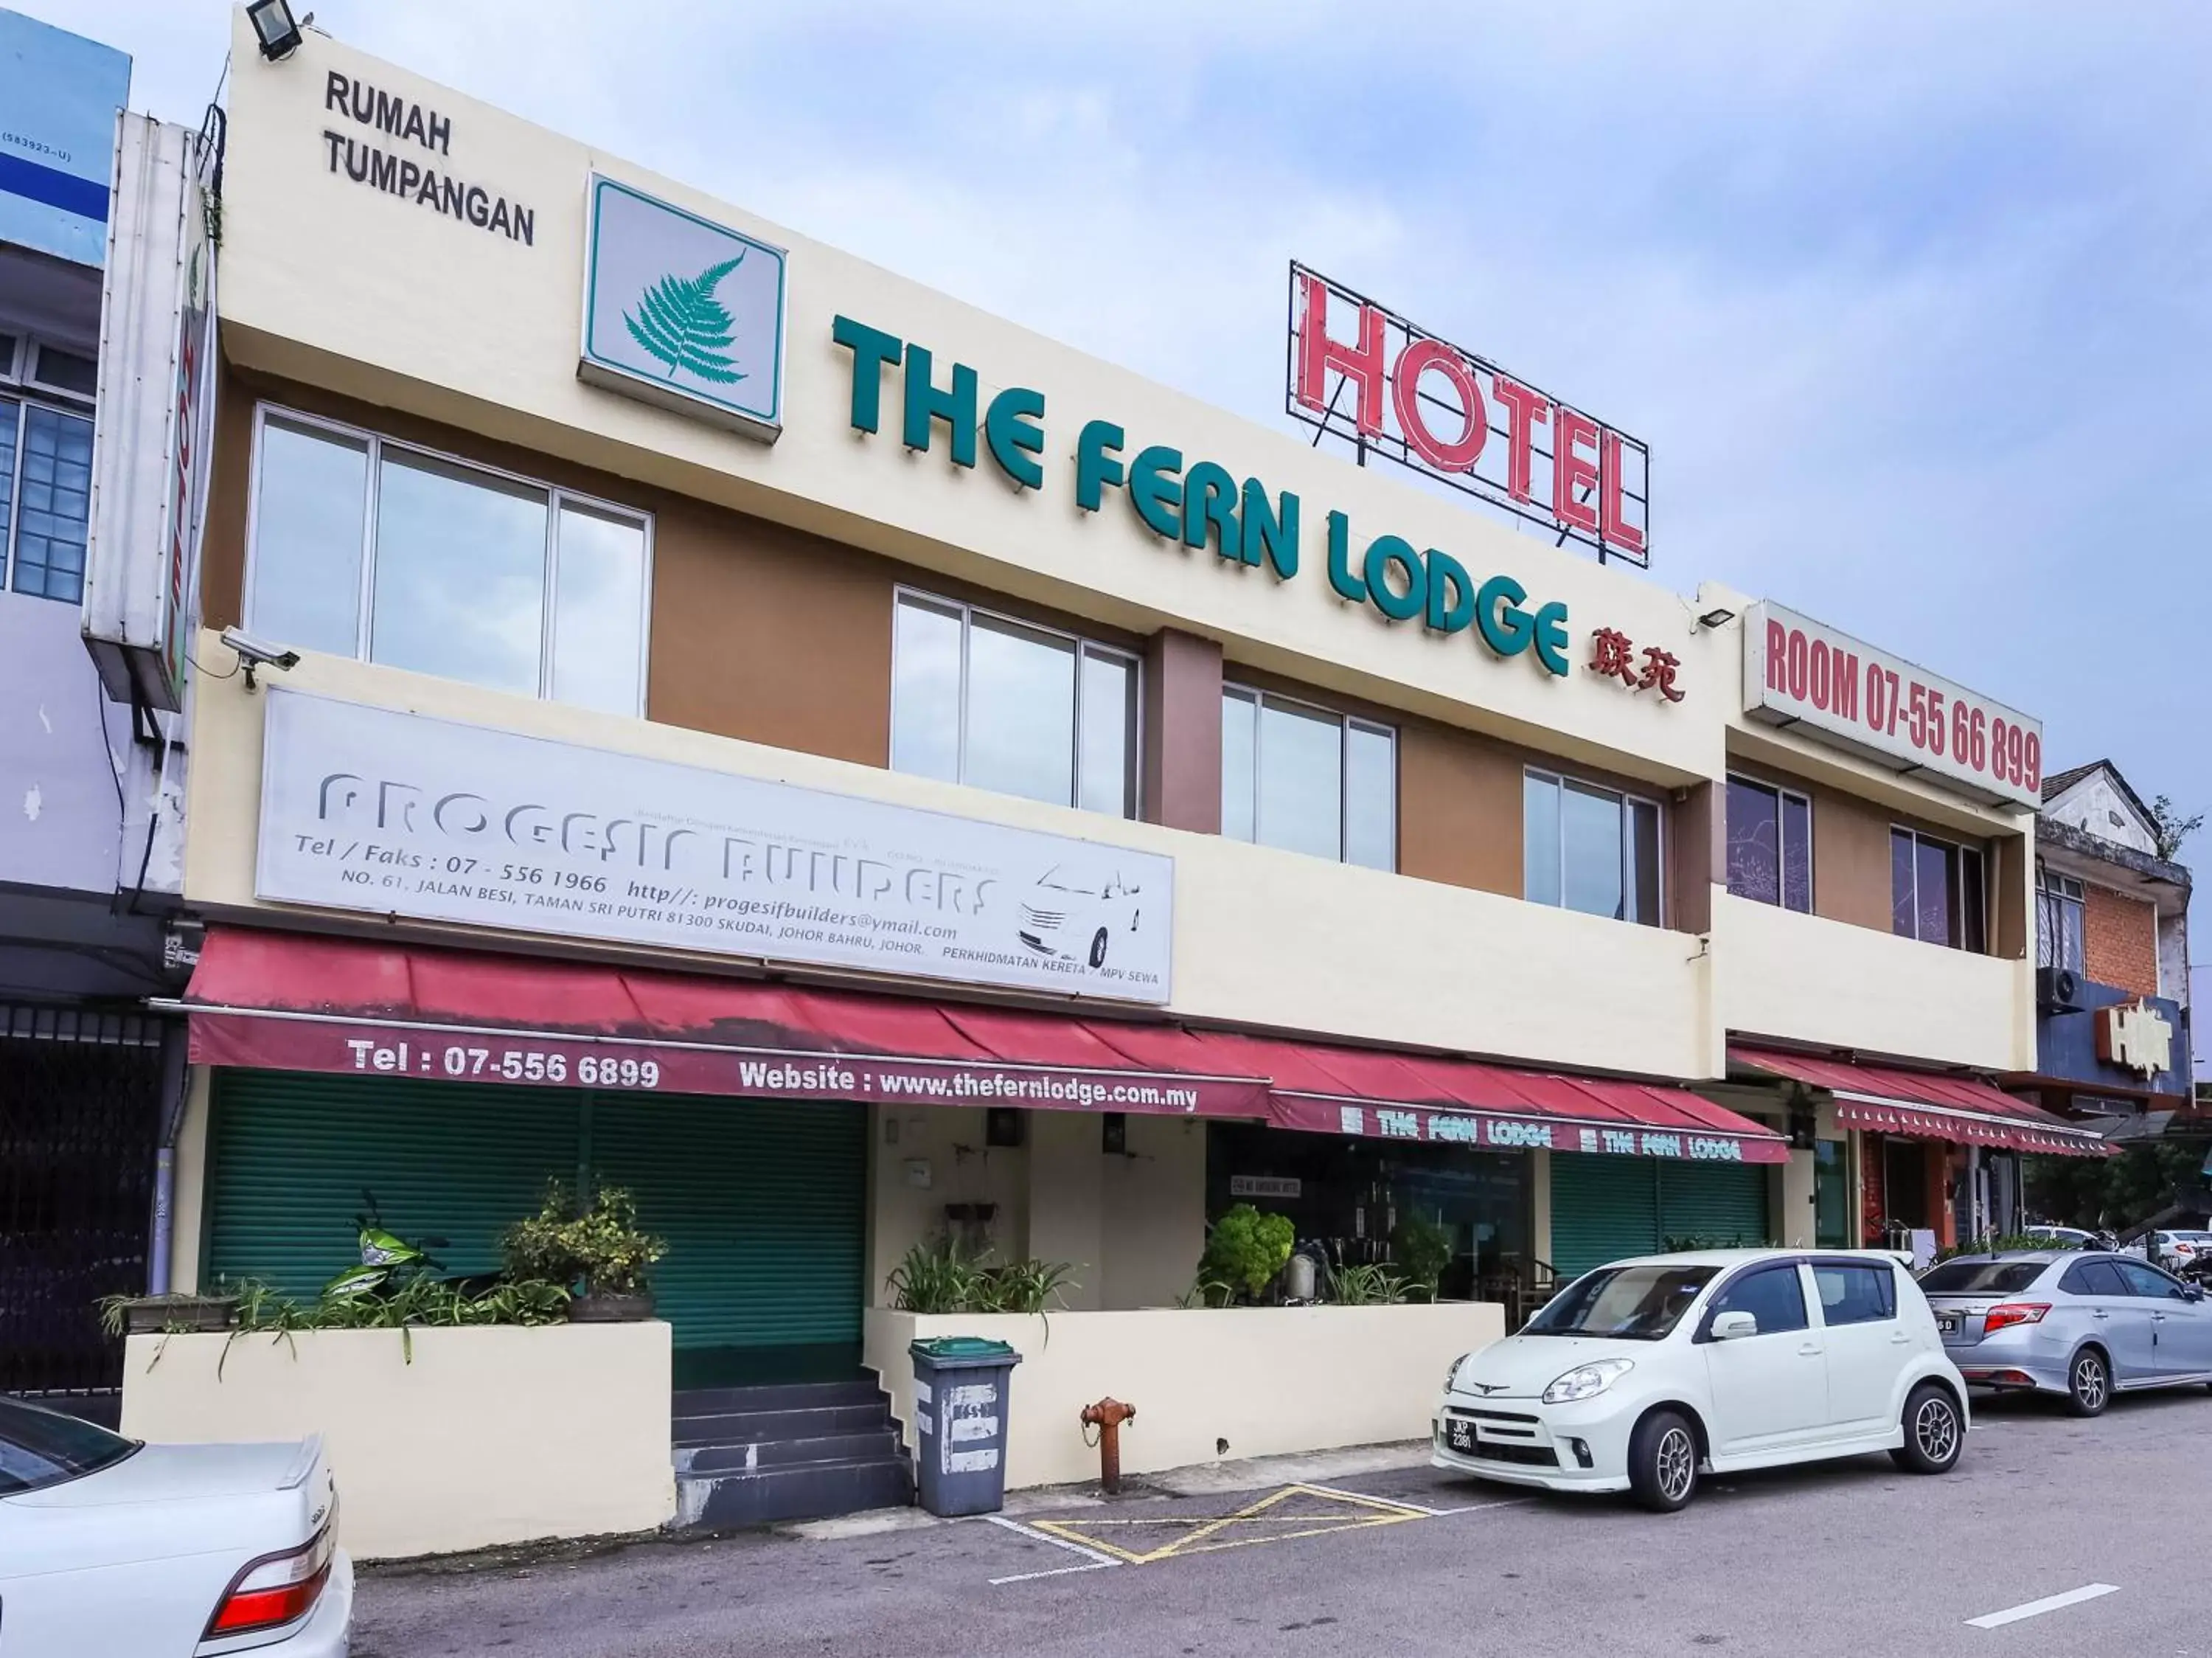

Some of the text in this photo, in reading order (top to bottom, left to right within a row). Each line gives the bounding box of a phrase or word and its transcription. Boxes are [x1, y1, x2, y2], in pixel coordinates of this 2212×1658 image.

[325, 70, 451, 156] RUMAH
[323, 131, 535, 247] TUMPANGAN
[1298, 272, 1647, 555] HOTEL
[832, 314, 1569, 677] THE FERN LODGE
[1767, 618, 2040, 792] ROOM 07-55 66 899
[295, 835, 335, 856] Tel
[365, 844, 422, 868] Faks
[446, 856, 477, 875] 07
[500, 864, 543, 884] 556
[553, 870, 608, 892] 1966
[704, 894, 957, 940] progesifbuilders@ymail.com
[341, 869, 375, 886] NO.
[416, 879, 473, 898] JALAN
[477, 887, 517, 906] BESI,
[525, 892, 584, 911] TAMAN
[588, 901, 613, 916] SRI
[617, 907, 662, 922] PUTRI
[666, 914, 713, 928] 81300
[718, 918, 773, 937] SKUDAI,
[777, 926, 824, 943] JOHOR
[828, 933, 875, 951] BAHRU,
[942, 946, 1037, 968] PERKHIDMATAN
[1042, 960, 1086, 976] KERETA
[1100, 967, 1125, 980] MPV
[1128, 971, 1159, 985] SEWA
[347, 1039, 408, 1072] Tel
[445, 1046, 567, 1082] 07-556
[578, 1056, 660, 1089] 6899
[739, 1061, 855, 1091] Website
[880, 1071, 1198, 1111] www.thefernlodge.com.my
